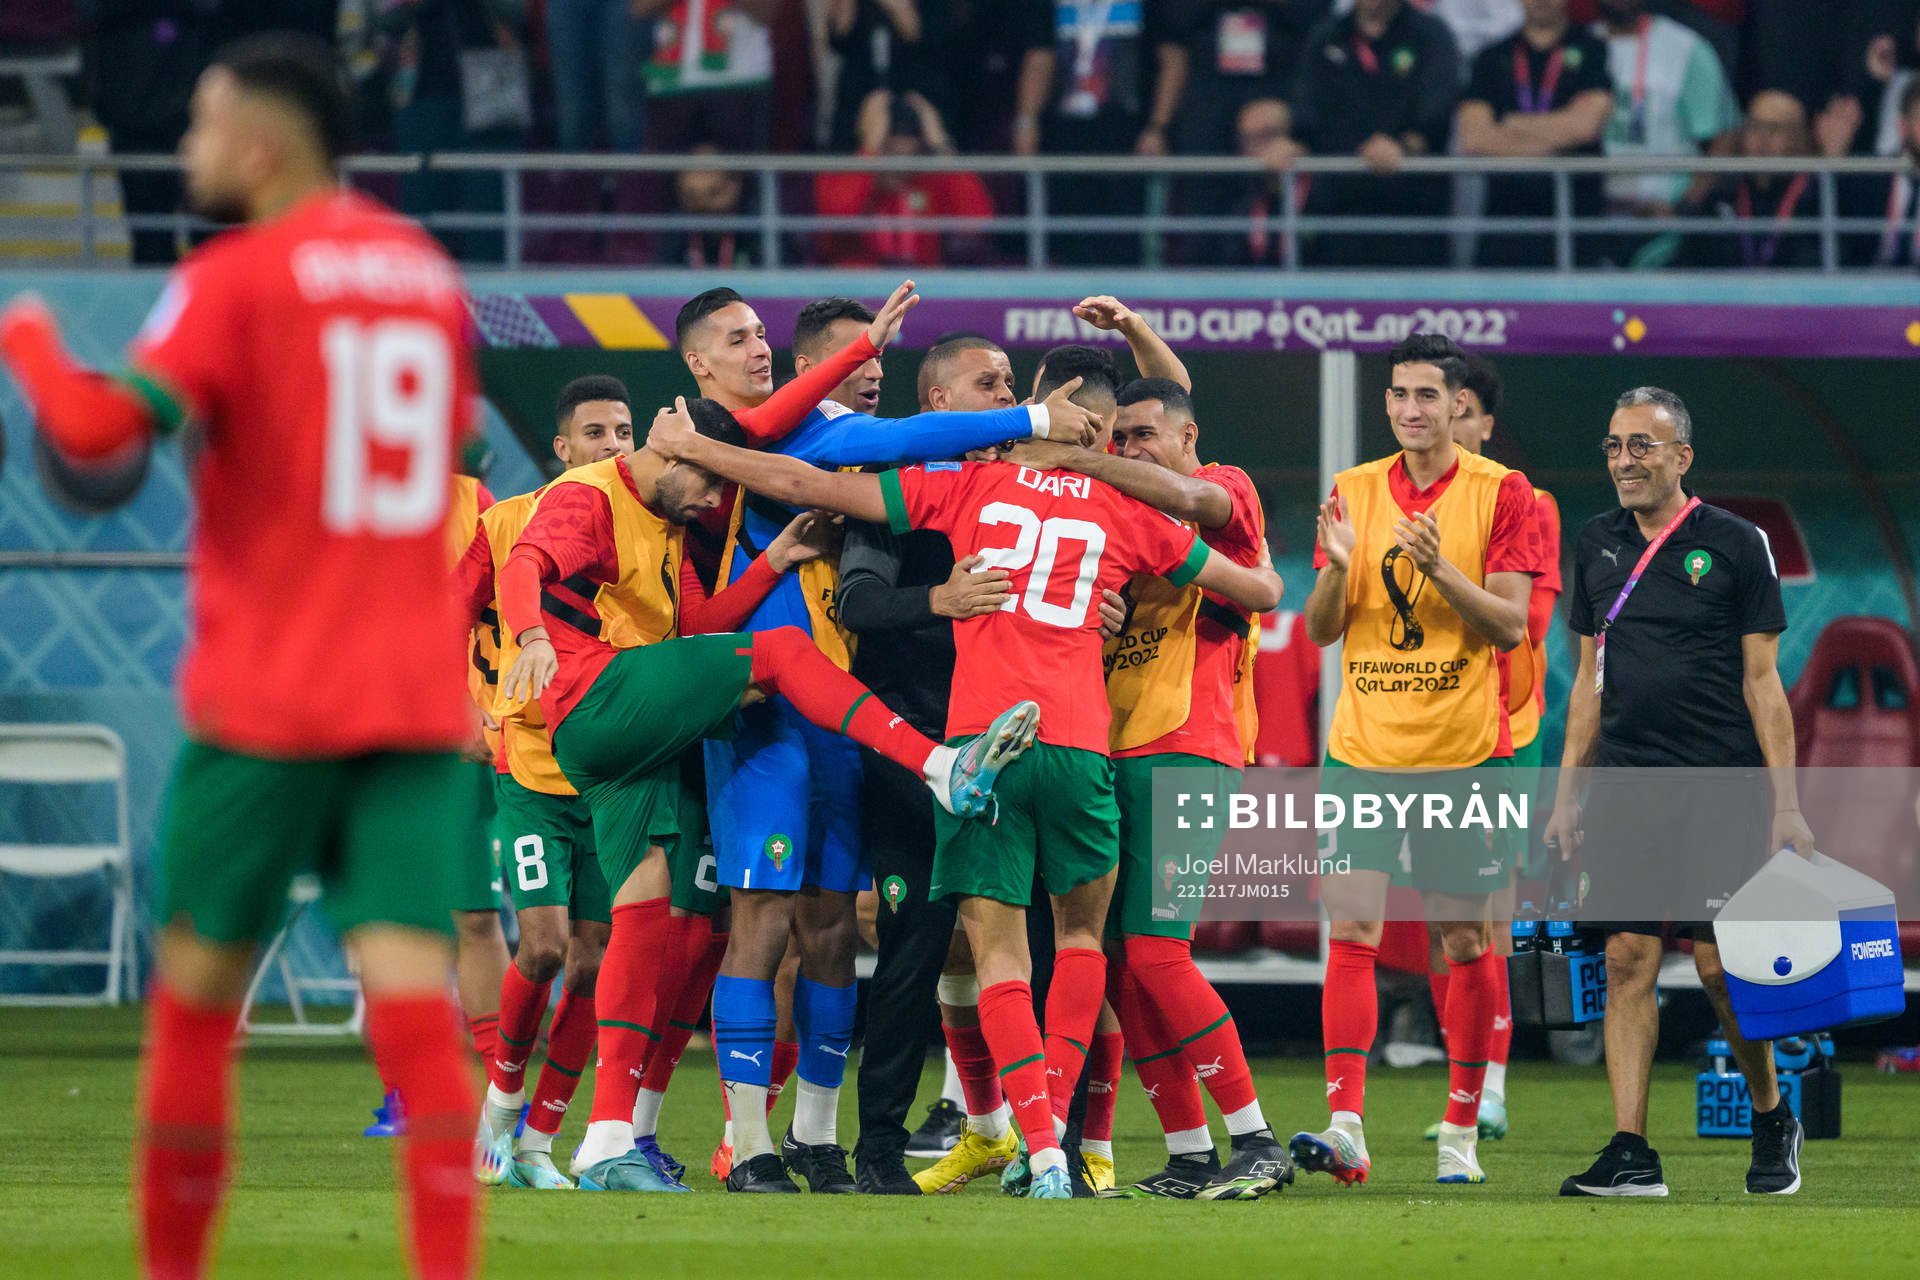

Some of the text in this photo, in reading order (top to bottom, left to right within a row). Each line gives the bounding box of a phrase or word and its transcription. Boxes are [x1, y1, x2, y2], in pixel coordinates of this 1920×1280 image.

[1005, 308, 1075, 341] FIFA
[1199, 308, 1263, 341] CUP
[320, 315, 453, 540] 19
[1016, 465, 1091, 499] DARI
[970, 501, 1107, 629] 20
[1440, 658, 1469, 673] CUP
[514, 834, 548, 892] 8
[1851, 938, 1895, 961] POWERADE
[1699, 1104, 1750, 1128] ADE
